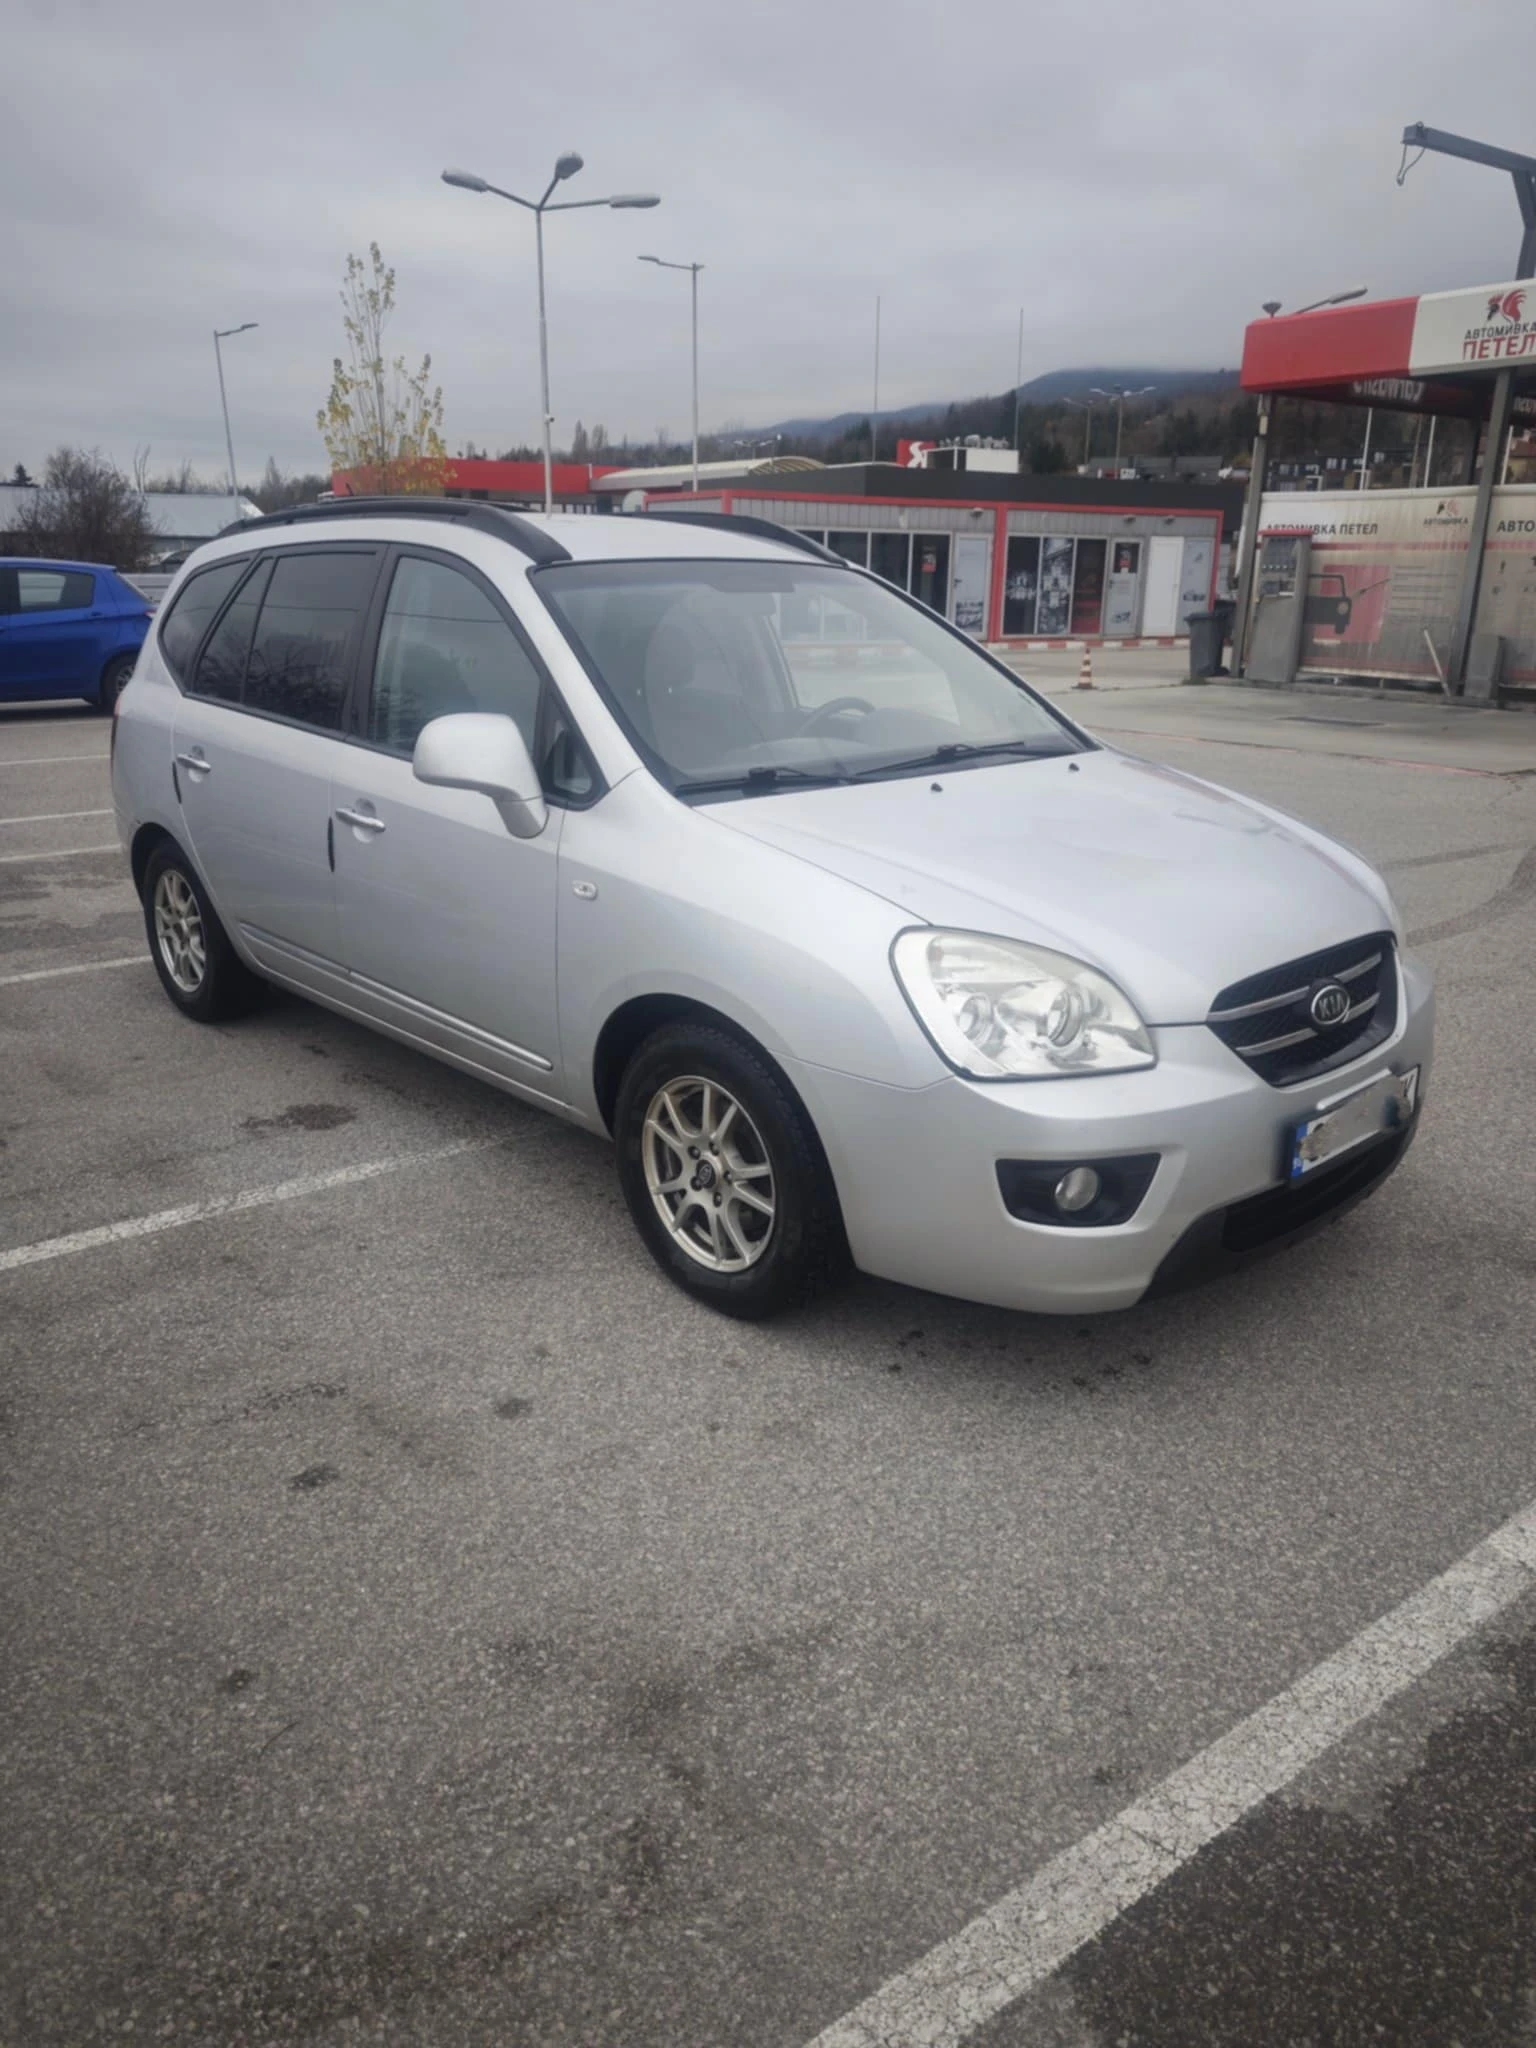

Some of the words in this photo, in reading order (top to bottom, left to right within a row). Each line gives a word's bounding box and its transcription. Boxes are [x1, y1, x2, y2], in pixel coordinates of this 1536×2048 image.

[1464, 321, 1536, 340] АВТОМИВКА
[1463, 333, 1536, 360] ПЕТЕЛ
[1340, 523, 1378, 536] ПЕТЕЛ
